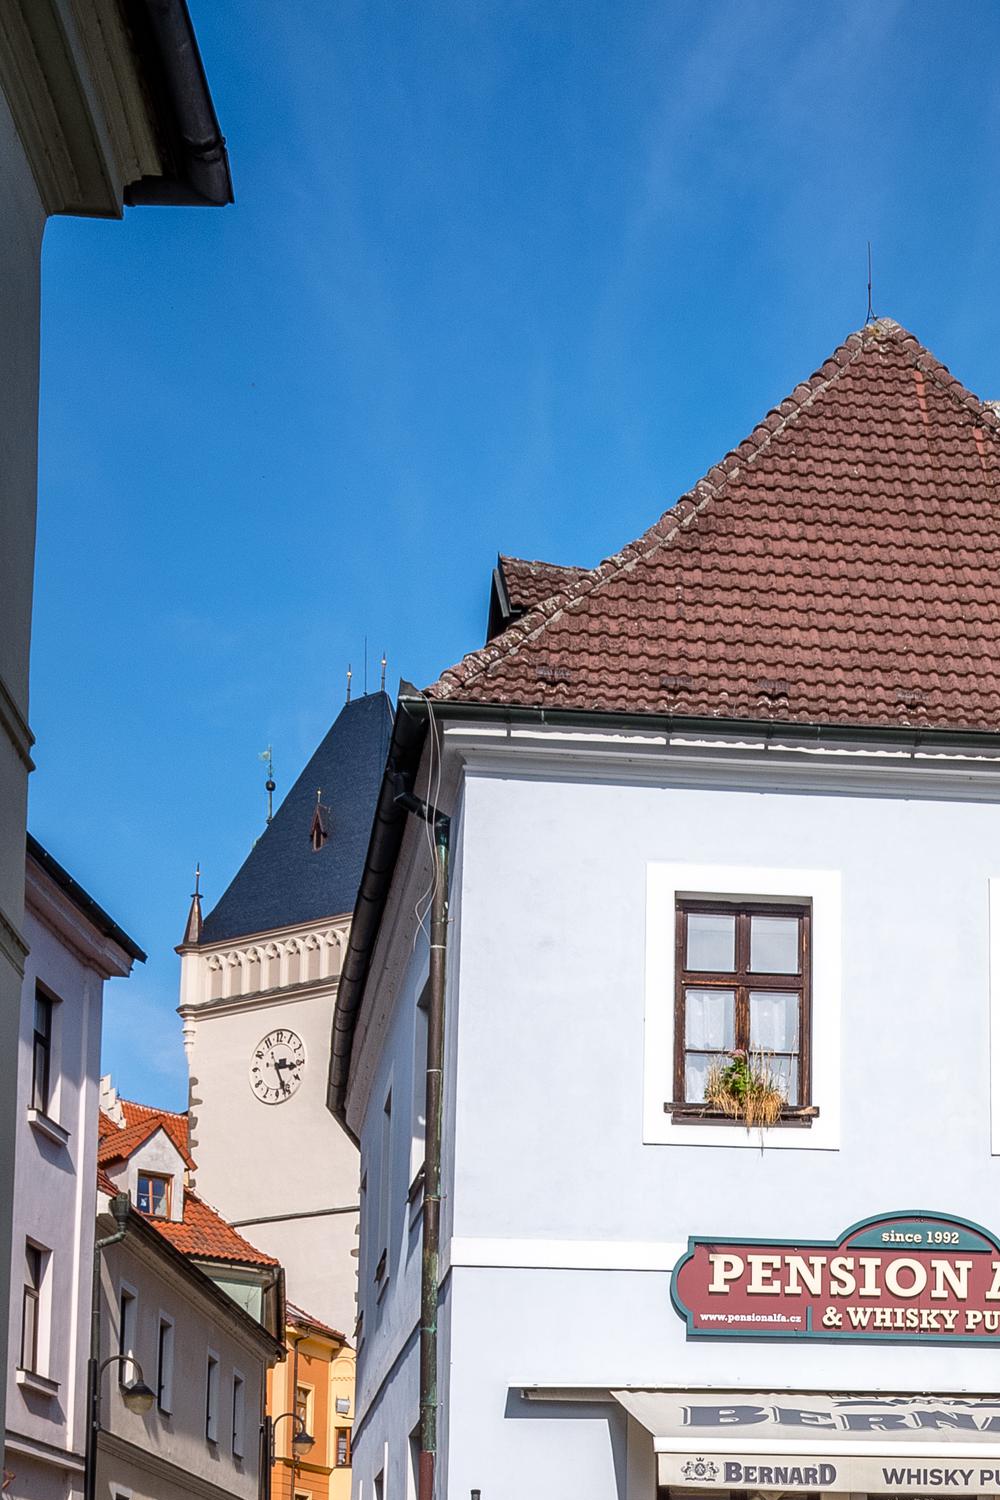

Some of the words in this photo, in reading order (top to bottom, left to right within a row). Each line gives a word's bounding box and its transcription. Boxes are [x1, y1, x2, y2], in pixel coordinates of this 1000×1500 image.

[882, 1230, 921, 1243] since
[927, 1231, 959, 1245] 1992
[708, 1253, 972, 1299] PENSION
[700, 1313, 801, 1323] www.pensionalfa.cz
[822, 1306, 843, 1327] &
[847, 1307, 959, 1331] WHISKY
[723, 1462, 836, 1486] BERNARD
[882, 1468, 974, 1486] WHISKY
